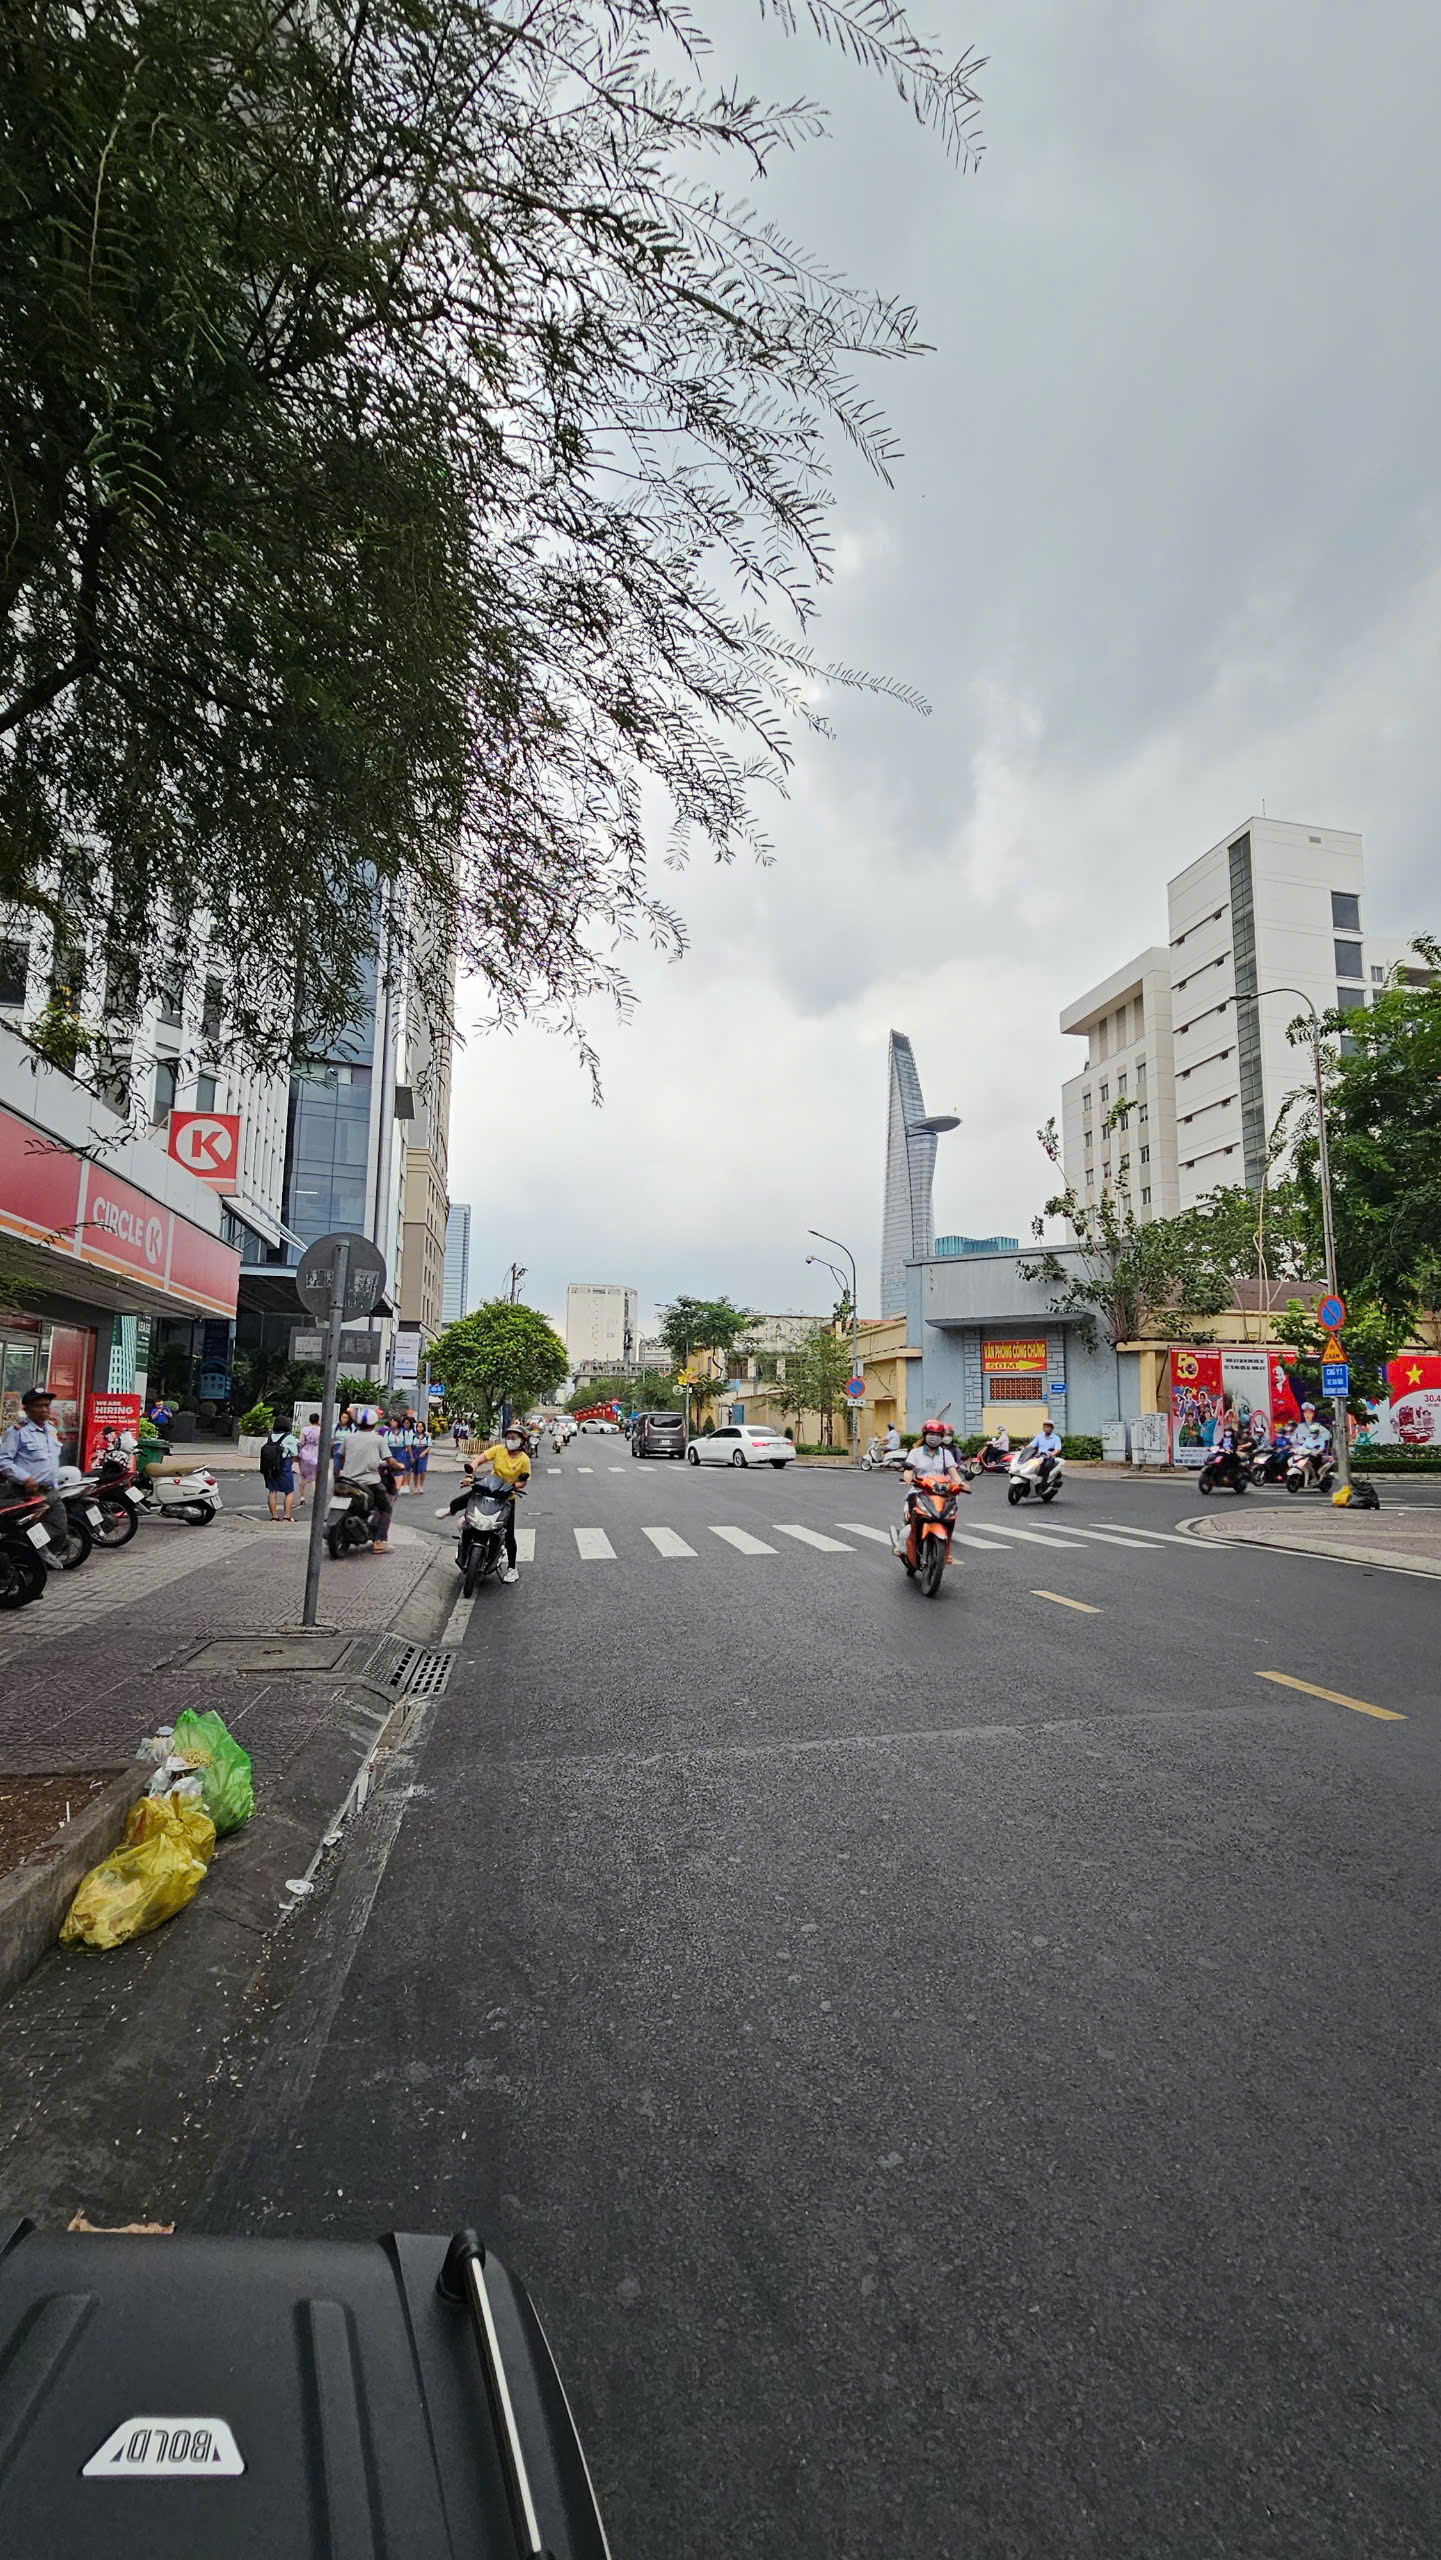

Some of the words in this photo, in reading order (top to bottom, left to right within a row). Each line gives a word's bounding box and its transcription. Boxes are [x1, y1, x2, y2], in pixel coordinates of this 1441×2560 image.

[183, 1124, 226, 1168] K
[93, 1196, 144, 1247] CIRCLE
[146, 1217, 162, 1264] K
[95, 1406, 133, 1415] HIRING
[126, 2429, 212, 2463] BOLD
